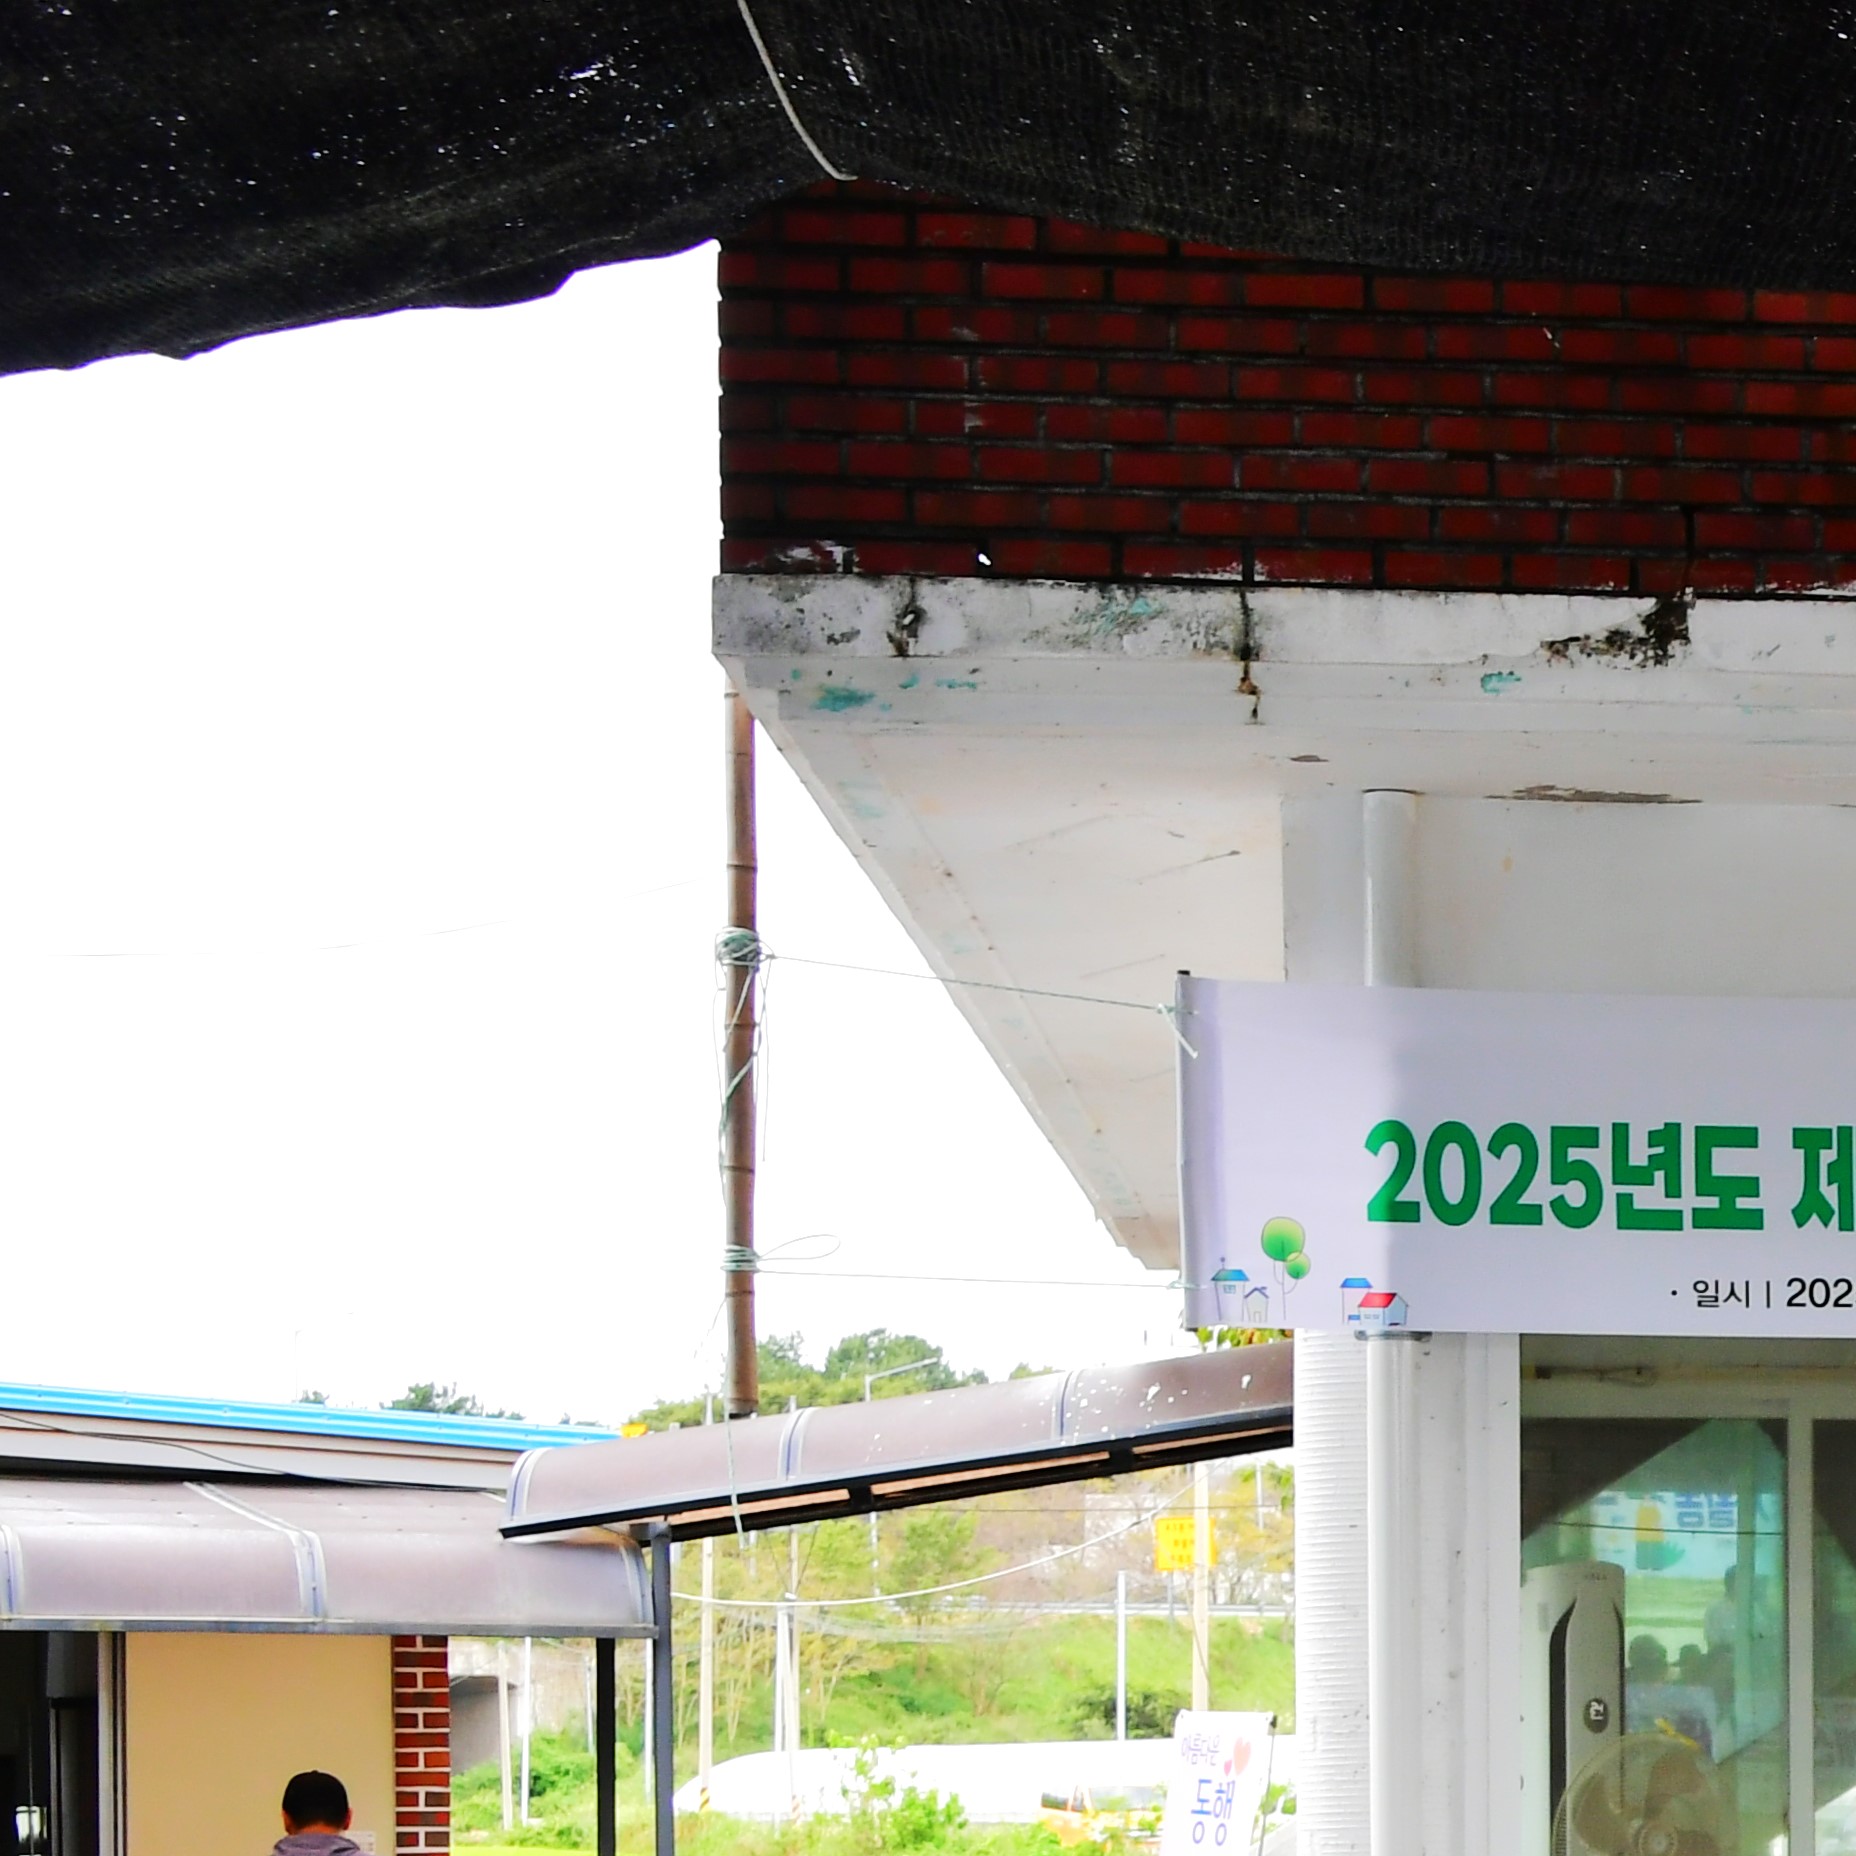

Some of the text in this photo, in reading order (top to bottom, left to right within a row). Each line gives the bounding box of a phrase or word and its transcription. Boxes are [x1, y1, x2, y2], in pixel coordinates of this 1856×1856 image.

[1365, 1119, 1765, 1233] 2025년도
[1692, 1279, 1750, 1309] 일시
[1190, 1778, 1237, 1847] 동행
